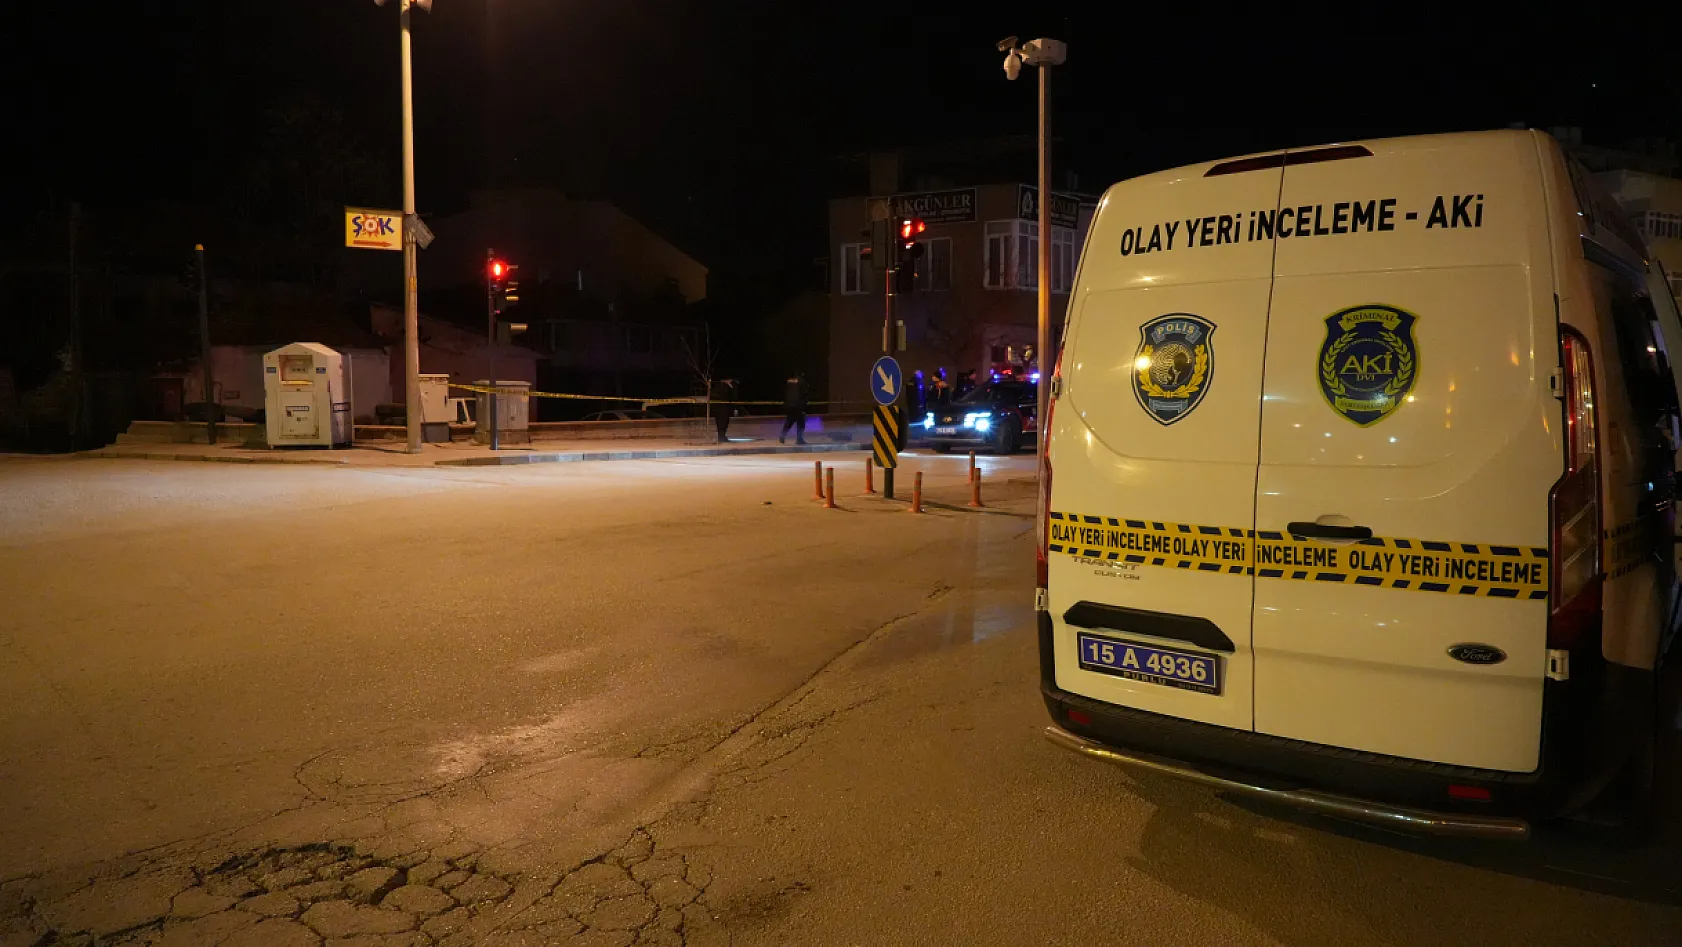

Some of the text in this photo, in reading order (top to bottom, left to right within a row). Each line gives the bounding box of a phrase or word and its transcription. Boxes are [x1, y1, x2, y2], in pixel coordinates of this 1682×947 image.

[352, 214, 394, 238] ŞOK
[1120, 221, 1180, 255] OLAY
[1052, 523, 1077, 541] OLAY
[1173, 537, 1209, 557] OLAY
[1349, 550, 1394, 573] OLAY
[1089, 643, 1207, 681] 15 A 4936
[1460, 648, 1493, 661] Ford
